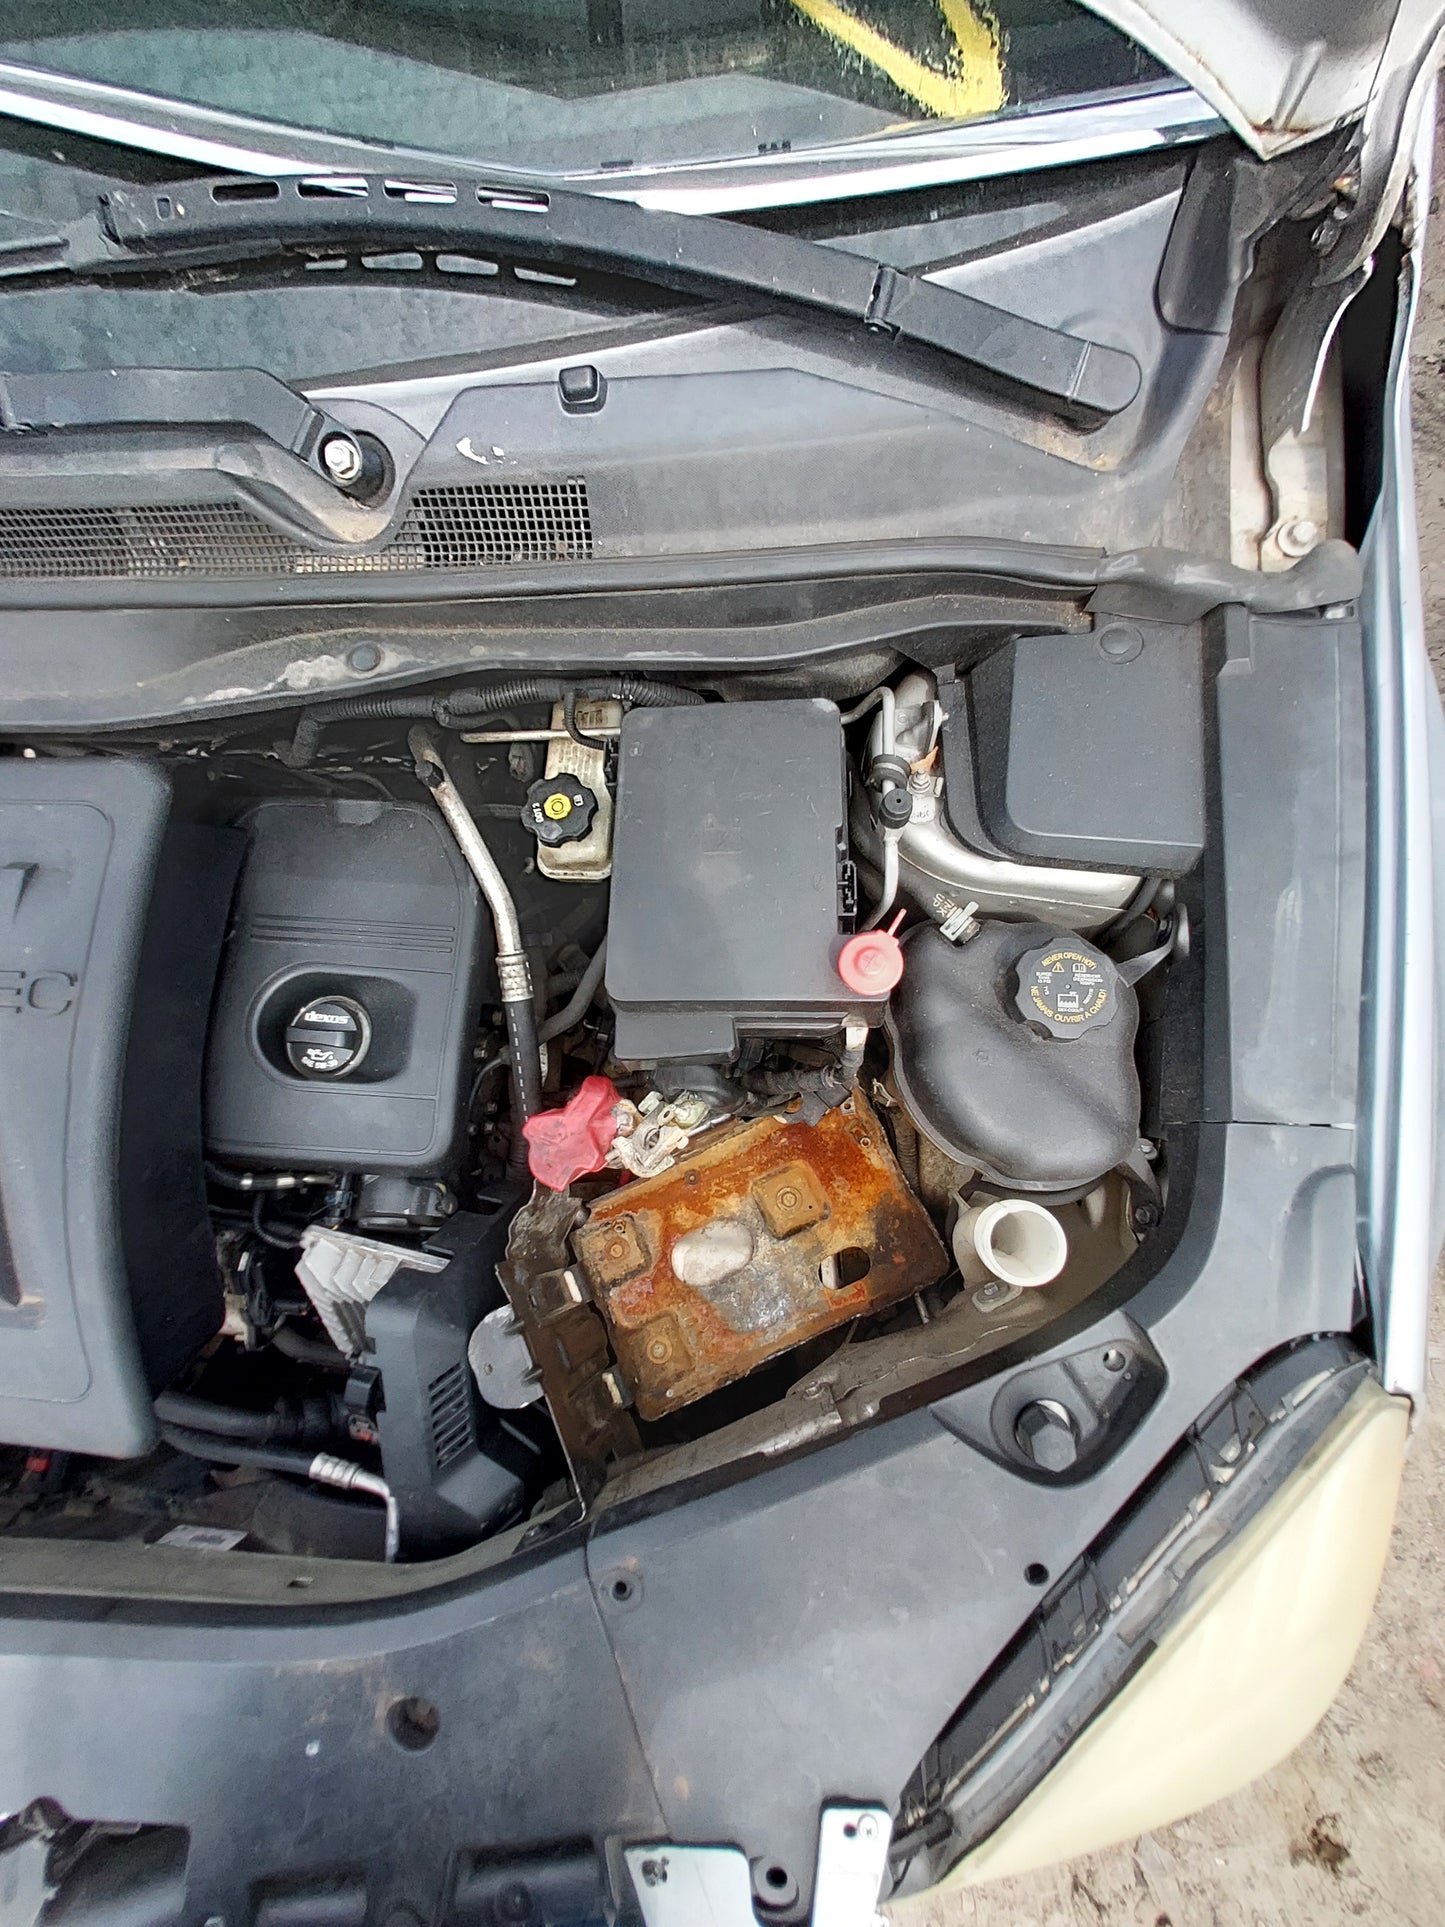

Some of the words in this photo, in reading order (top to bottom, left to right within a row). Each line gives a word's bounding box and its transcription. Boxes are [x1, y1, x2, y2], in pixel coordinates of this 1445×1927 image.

[1041, 952, 1064, 967] NEVER
[1063, 952, 1083, 962] OPEN
[1030, 985, 1040, 997] NE
[1032, 996, 1054, 1018] JAMAIS
[304, 1010, 351, 1025] dexos
[1054, 1013, 1085, 1023] OUVRIR
